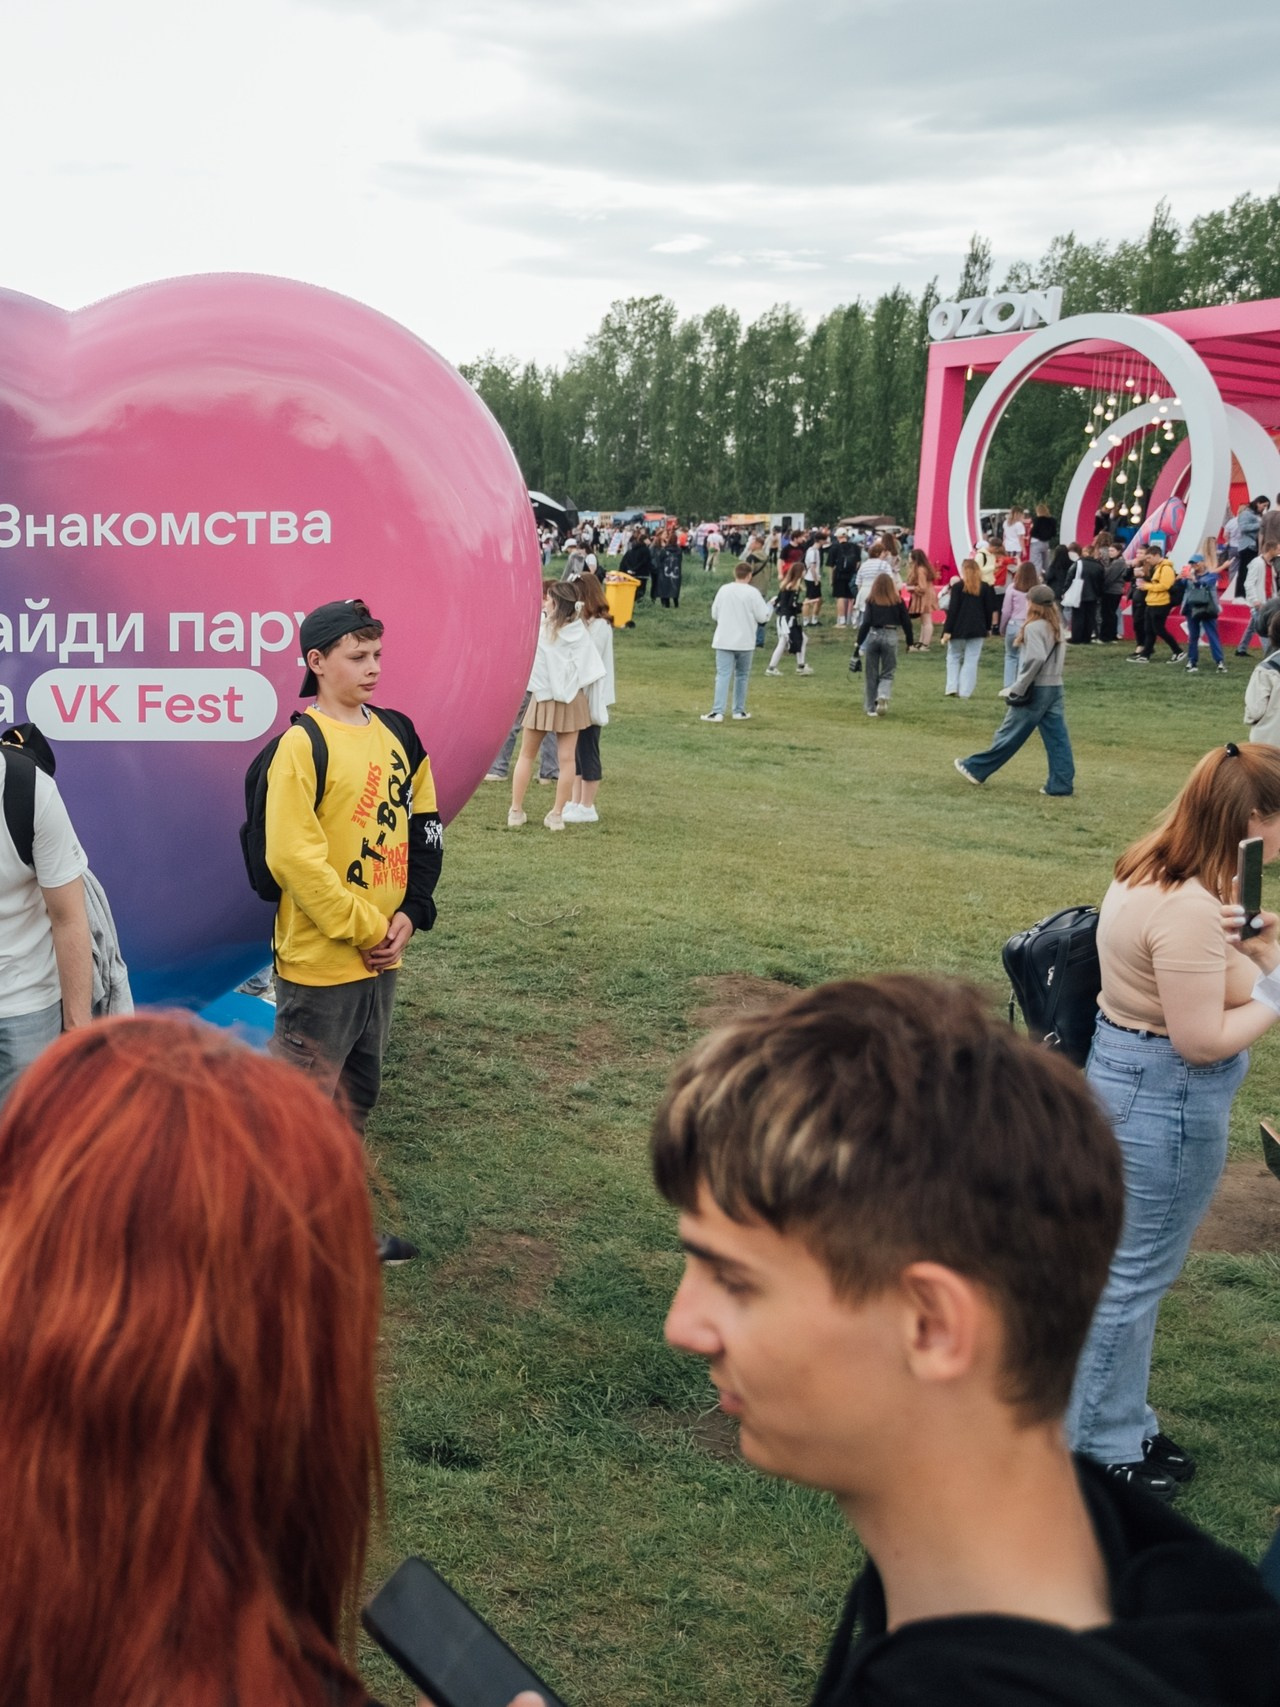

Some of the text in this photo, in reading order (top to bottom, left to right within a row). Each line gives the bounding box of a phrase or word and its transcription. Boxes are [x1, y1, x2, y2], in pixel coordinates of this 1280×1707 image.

[928, 286, 1063, 341] OZON
[50, 685, 121, 723] VK
[138, 685, 244, 723] Fest
[354, 762, 383, 818] YOURS
